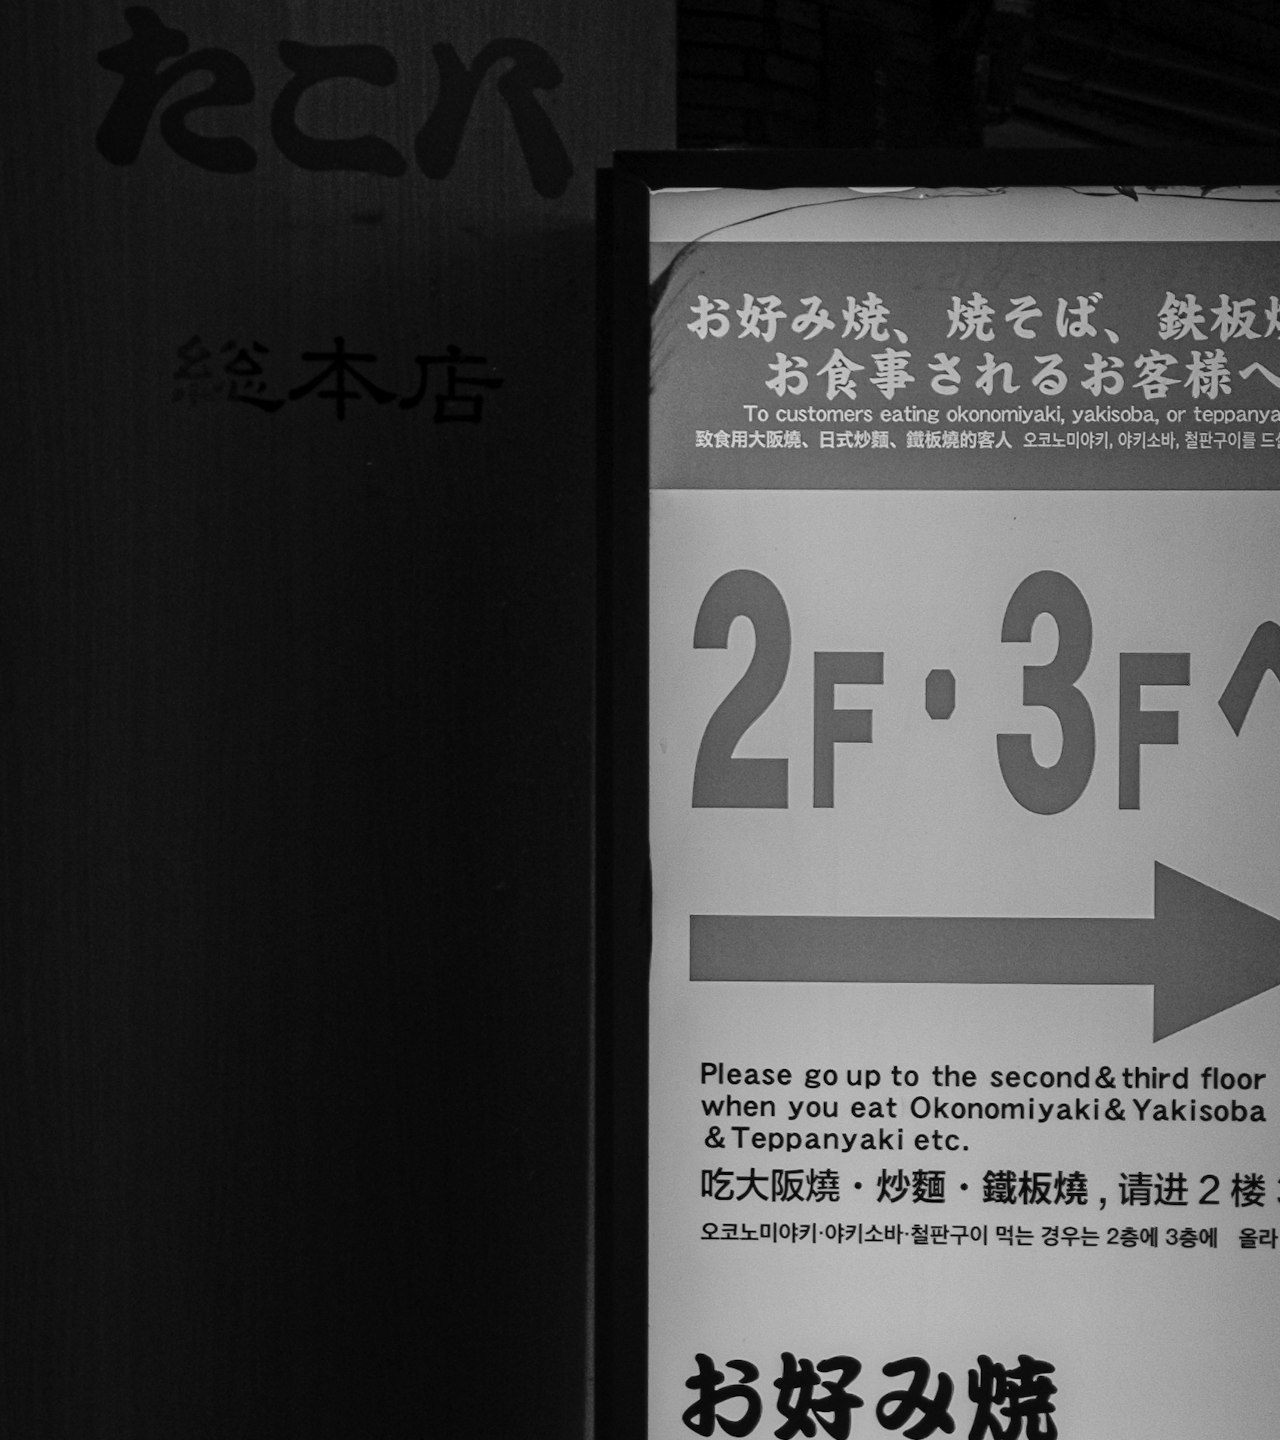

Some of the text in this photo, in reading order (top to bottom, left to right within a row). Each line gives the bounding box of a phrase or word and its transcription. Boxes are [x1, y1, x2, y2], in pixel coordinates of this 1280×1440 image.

[171, 334, 505, 425] 総本店
[742, 405, 769, 422] To
[775, 406, 873, 422] customers
[880, 406, 940, 424] eating
[946, 406, 1065, 425] okonomiyaki,
[1072, 406, 1160, 425] yakisoba,
[1166, 409, 1187, 423] or
[1023, 431, 1114, 450] 오코노미야키,
[1118, 431, 1181, 449] 야키소바,
[1184, 431, 1257, 449] 철판구이를
[700, 1062, 793, 1085] Please
[804, 1068, 839, 1089] go
[847, 1068, 882, 1089] up
[890, 1065, 919, 1087] to
[932, 1065, 977, 1088] the
[1200, 1066, 1267, 1090] floor
[700, 1094, 776, 1117] when
[788, 1099, 839, 1121] you
[850, 1096, 898, 1118] eat
[913, 1128, 970, 1152] etc.
[995, 1224, 1035, 1247] 먹는
[1040, 1225, 1101, 1248] 경우는
[1106, 1226, 1159, 1249] 2층에
[1165, 1226, 1219, 1249] 3층에
[1238, 1227, 1279, 1250] 올라
